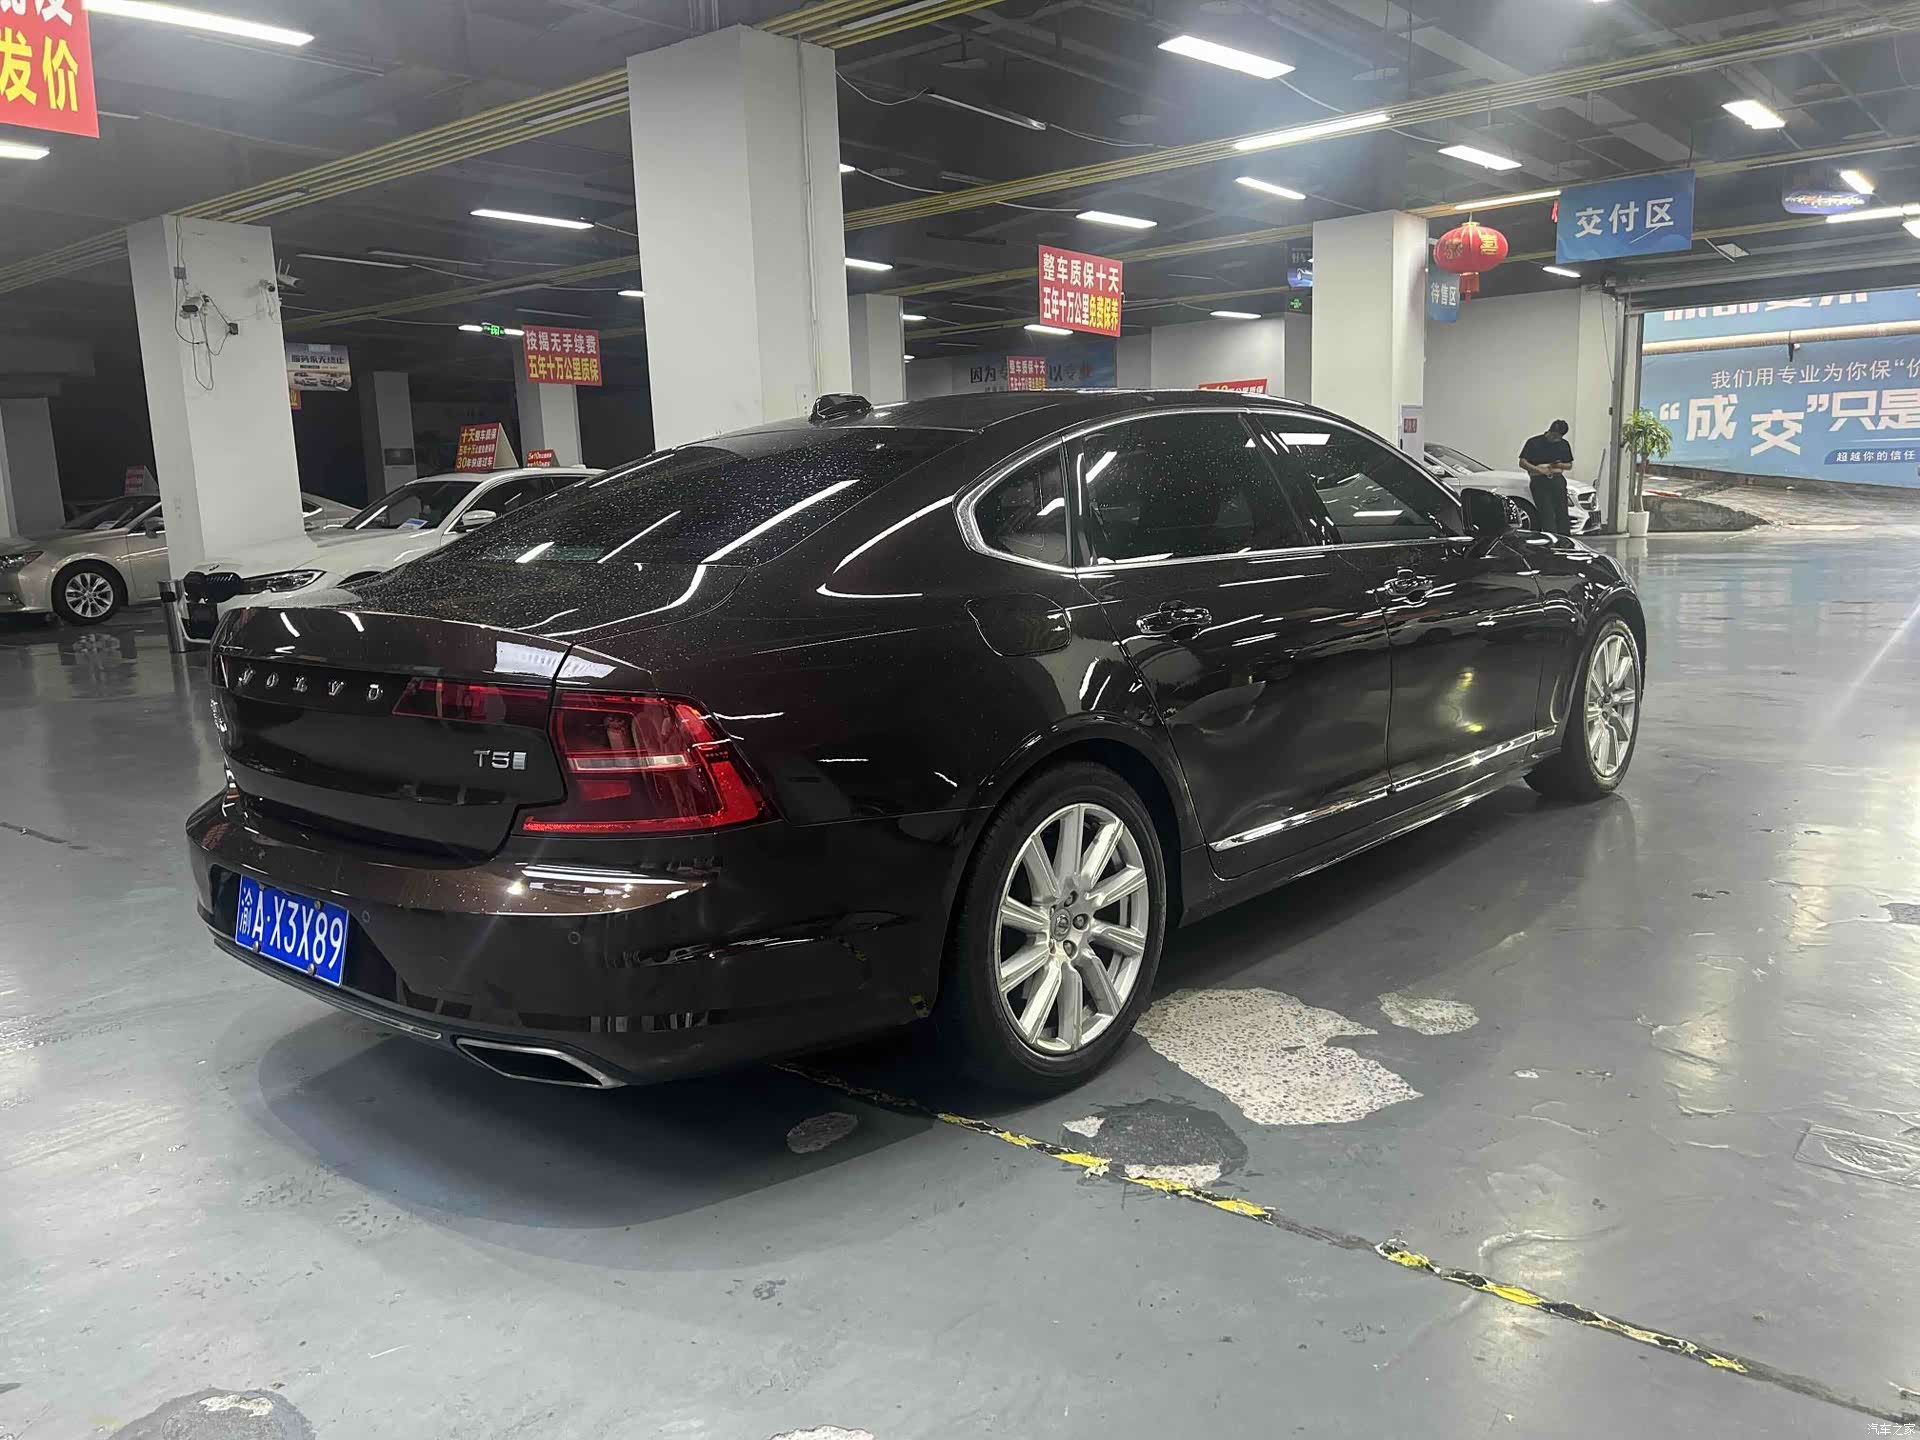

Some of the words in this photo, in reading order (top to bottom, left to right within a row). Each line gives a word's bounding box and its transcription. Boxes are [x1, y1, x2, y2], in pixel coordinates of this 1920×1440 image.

[1575, 197, 1674, 239] 交付区
[1043, 252, 1119, 293] 整车质保十天
[1043, 286, 1119, 332] 五年十万公里免费保养
[526, 330, 597, 354] 按揭无手续费
[528, 353, 599, 382] 五年十万公里质保
[1836, 449, 1916, 463] 超越你的信任
[238, 667, 384, 701] VOLVO
[473, 749, 511, 769] T5
